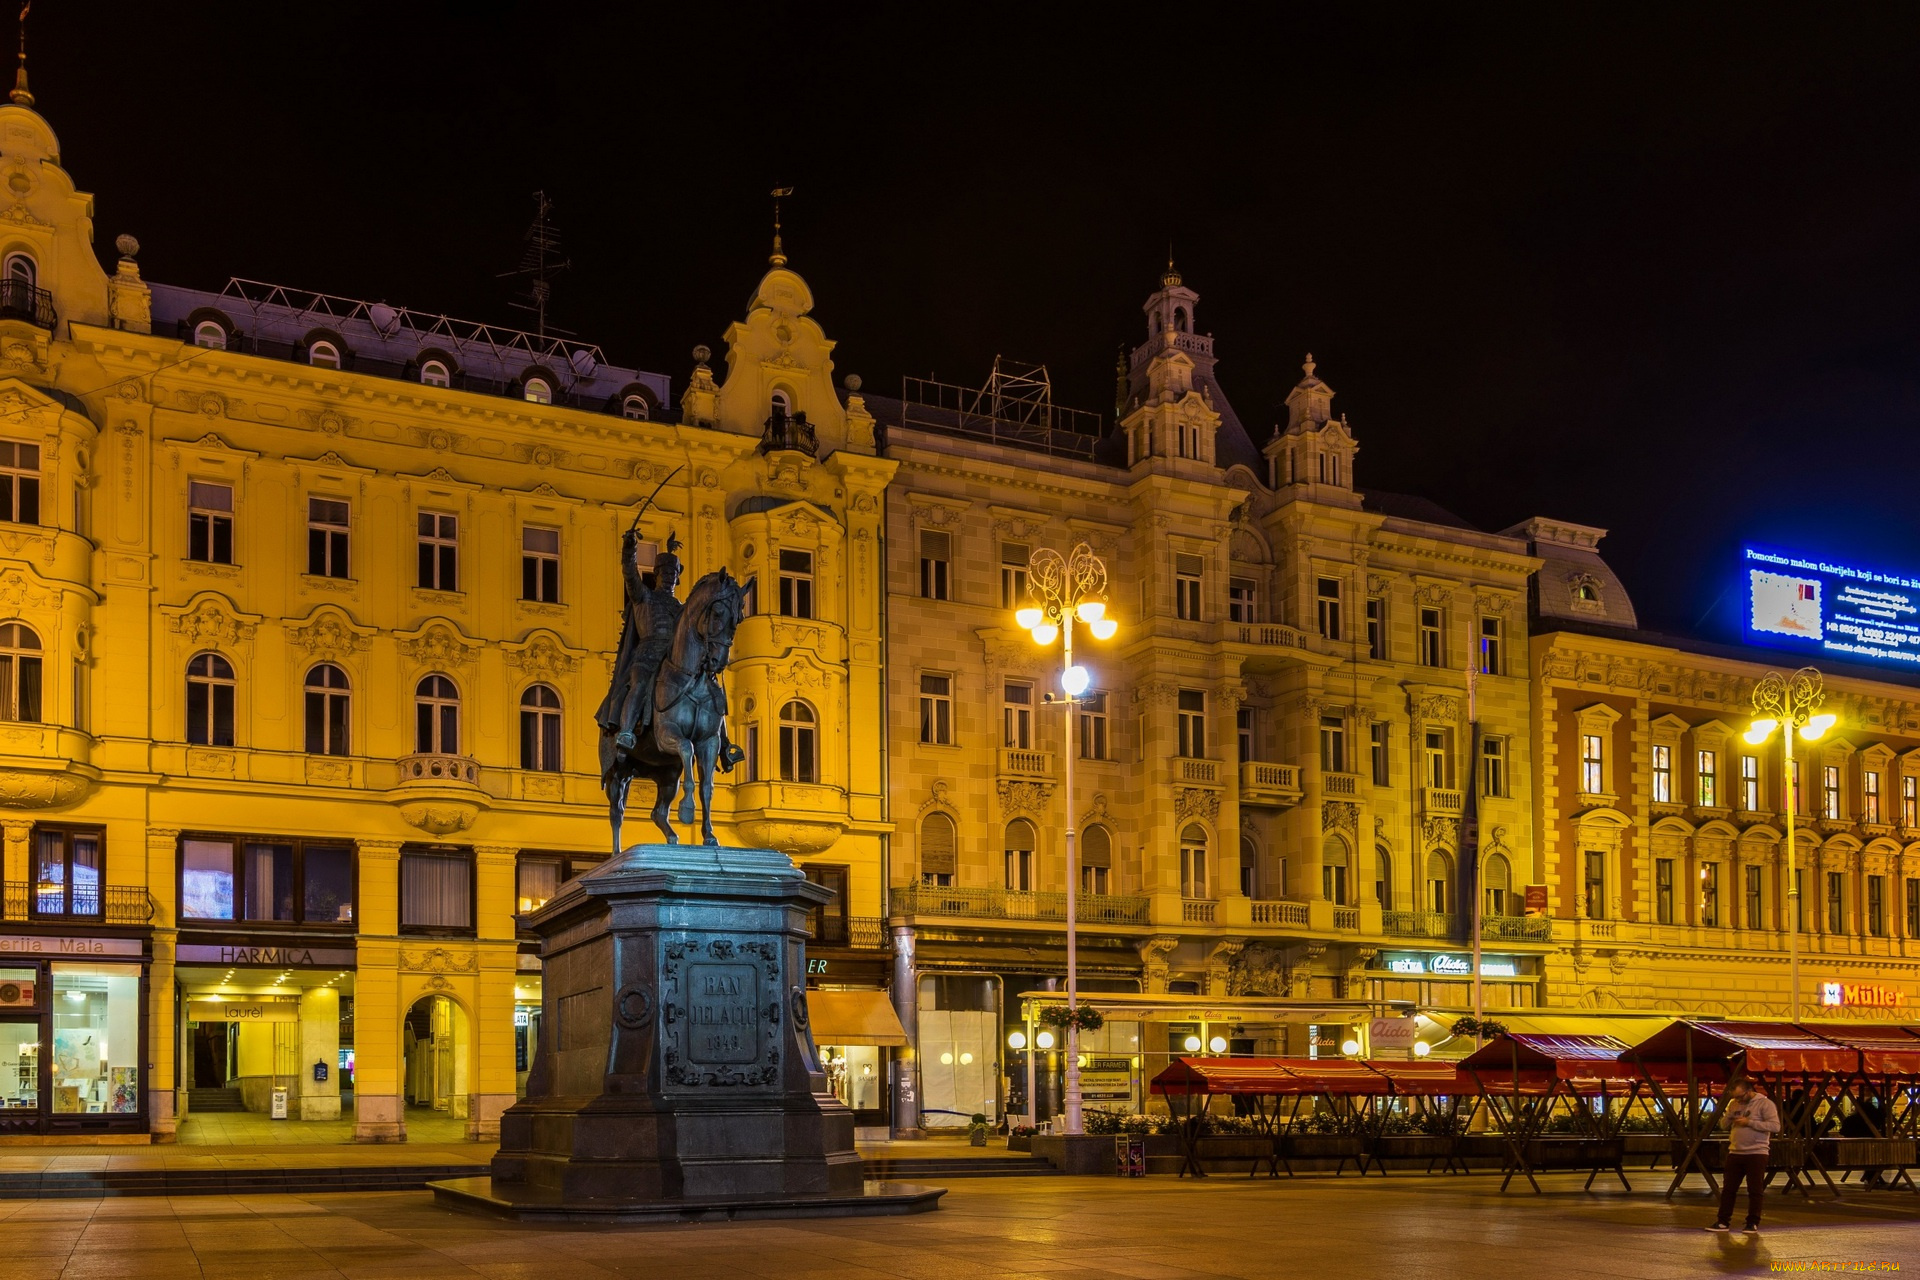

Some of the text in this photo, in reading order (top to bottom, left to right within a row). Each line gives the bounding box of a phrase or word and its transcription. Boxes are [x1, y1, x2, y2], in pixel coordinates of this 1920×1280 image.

[1746, 549, 1789, 565] Pomozimo
[1790, 558, 1818, 570] malom
[1819, 562, 1855, 578] Gabrijelu
[1857, 570, 1872, 582] koji
[1883, 574, 1899, 585] bori
[60, 938, 104, 953] Mala
[221, 947, 314, 964] HARMICA
[704, 976, 740, 995] BAN
[1843, 984, 1904, 1006] Müller
[225, 1005, 263, 1018] Laurèl
[1371, 1021, 1410, 1038] Aida
[1310, 1036, 1335, 1046] Aida
